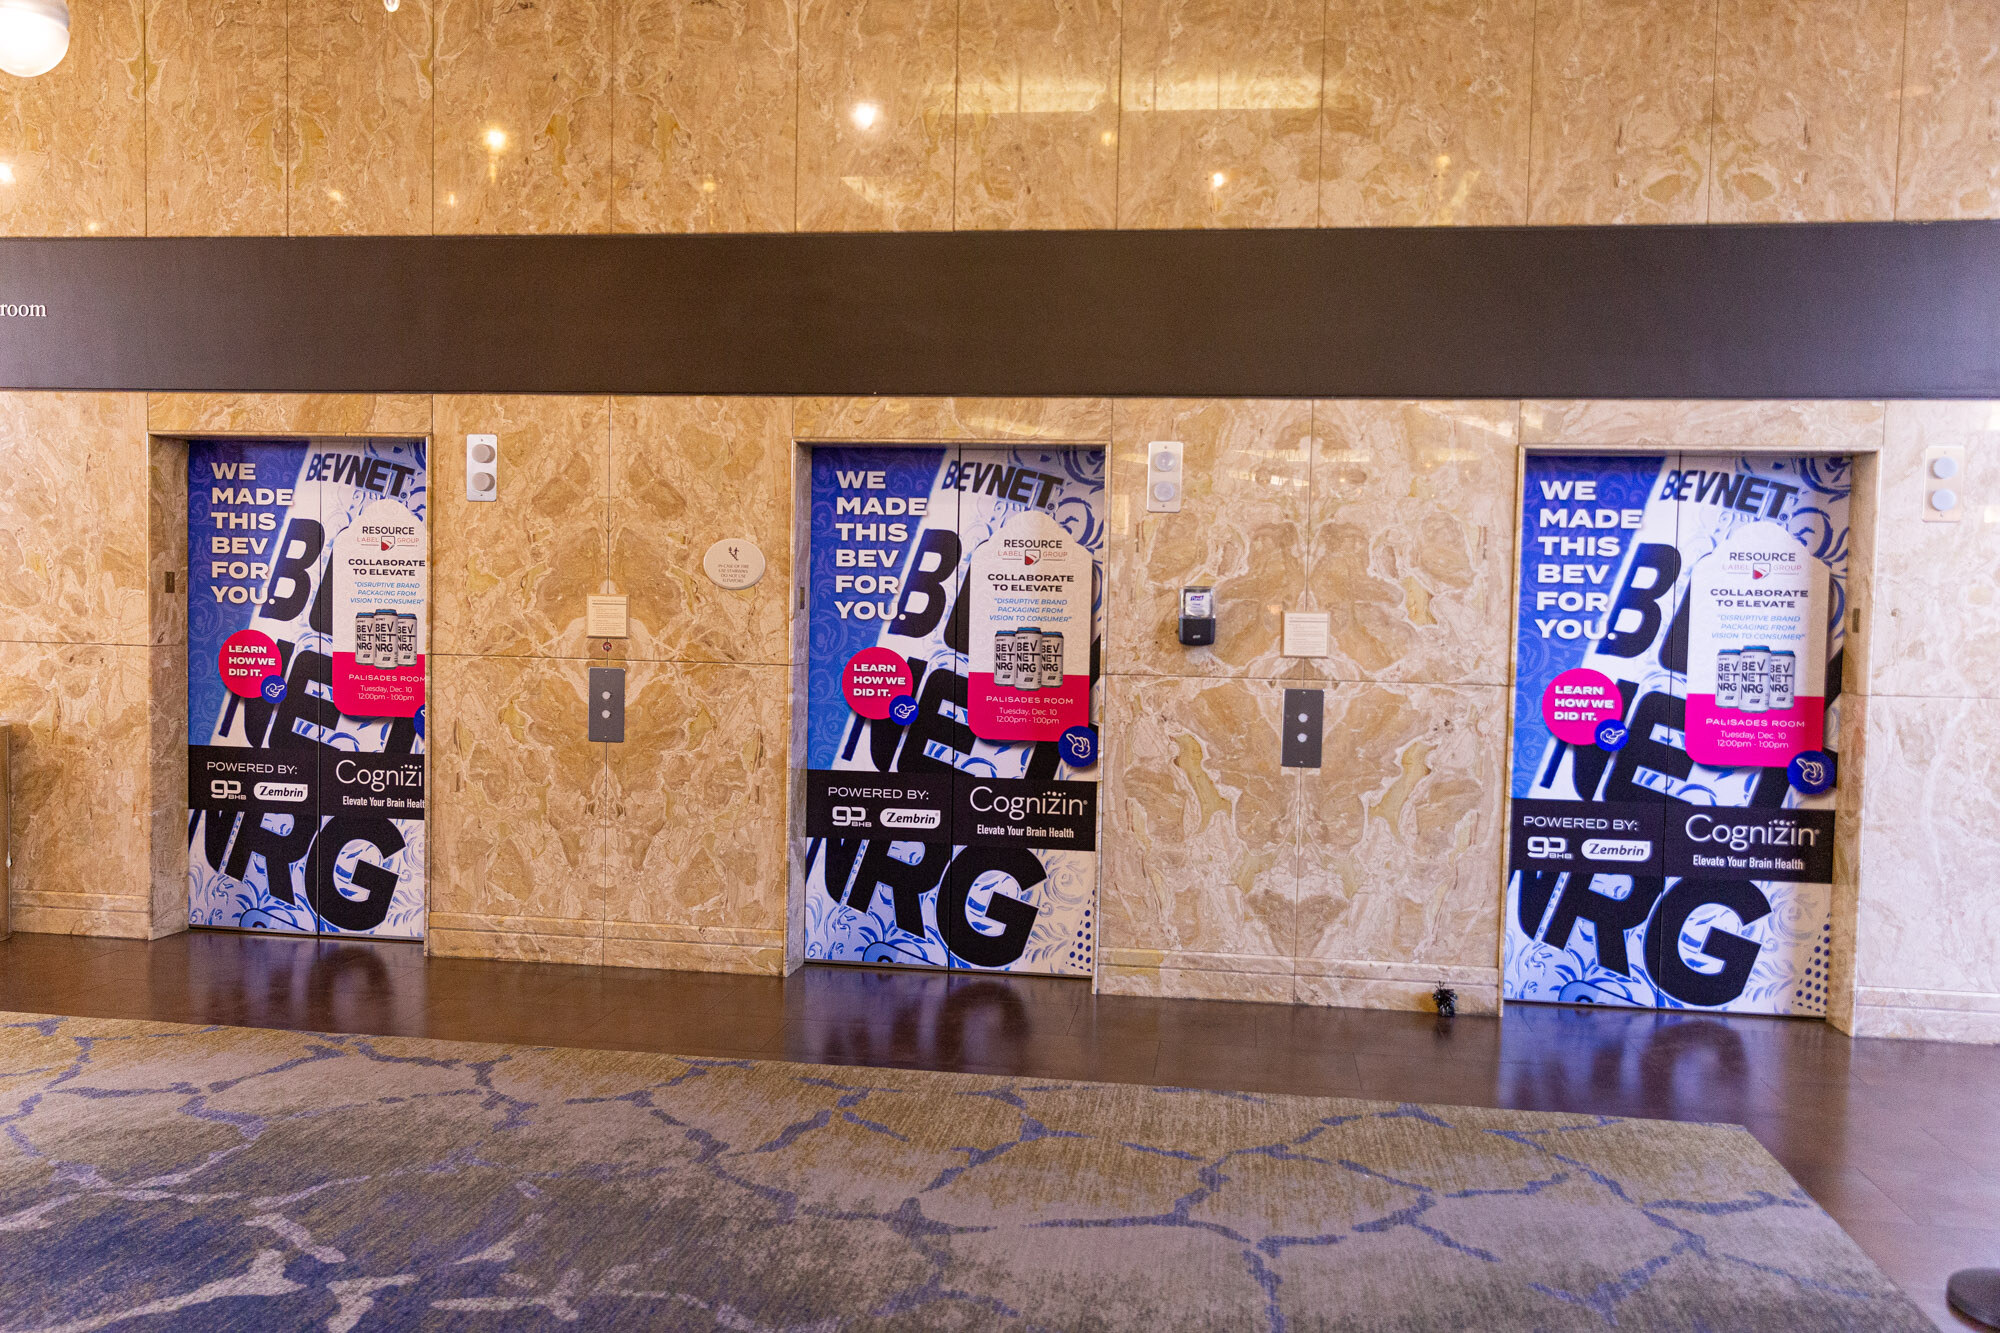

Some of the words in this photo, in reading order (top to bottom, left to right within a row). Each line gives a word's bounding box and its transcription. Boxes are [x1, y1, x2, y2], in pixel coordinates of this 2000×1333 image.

[0, 304, 46, 316] room
[212, 462, 256, 480] WE
[306, 452, 415, 498] BEVNET
[836, 470, 886, 489] WE
[942, 460, 1064, 510] BEVNET
[1540, 480, 1596, 500] WE
[211, 488, 294, 506] MADE
[1659, 470, 1799, 520] BEVNET
[836, 498, 927, 516] MADE
[211, 512, 276, 530] THIS
[1540, 508, 1642, 529] MADE
[362, 526, 415, 535] RESOURCE
[836, 523, 908, 542] THIS
[211, 537, 268, 554] BEV
[1004, 540, 1062, 548] RESOURCE
[1538, 536, 1620, 557] THIS
[836, 550, 899, 568] BEV
[1729, 552, 1796, 562] RESOURCE
[348, 558, 426, 567] COLLABORATE
[211, 562, 269, 580] FOR
[369, 568, 416, 576] ELEVATE
[1538, 564, 1609, 584] BEV
[988, 574, 1074, 582] COLLABORATE
[836, 576, 899, 594] FOR
[1010, 584, 1062, 592] ELEVATE
[211, 586, 275, 604] YOU.
[1710, 588, 1808, 598] COLLABORATE
[1536, 592, 1609, 612] FOR
[1716, 600, 1734, 608] TO
[1736, 600, 1795, 608] ELEVATE
[834, 602, 906, 620] YOU.
[356, 624, 373, 632] BEV
[376, 622, 394, 632] BEV
[1536, 619, 1616, 640] YOU.
[376, 634, 396, 642] NET
[228, 645, 267, 654] LEARN
[356, 642, 372, 650] NRG
[376, 644, 392, 652] NRG
[996, 642, 1014, 652] BEV
[1017, 640, 1038, 652] BEV
[228, 658, 256, 666] HOW
[258, 658, 276, 666] WE
[996, 653, 1015, 661] NET
[1017, 653, 1040, 662] NET
[854, 664, 896, 672] LEARN
[996, 662, 1013, 670] NRG
[1016, 664, 1036, 673] NRG
[1718, 662, 1738, 672] BEV
[1742, 659, 1765, 671] BEV
[250, 669, 262, 677] IT.
[1742, 673, 1768, 682] NET
[854, 676, 884, 684] HOW
[886, 677, 906, 685] WE
[360, 685, 388, 694] Tuesday,
[854, 688, 874, 696] DID
[877, 688, 891, 697] IT.
[1556, 686, 1604, 696] LEARN
[1718, 683, 1737, 692] NRG
[1742, 684, 1763, 694] NRG
[358, 693, 384, 701] 12:00pm
[986, 696, 1040, 704] PALISADES
[1044, 696, 1074, 704] ROOM
[1555, 699, 1589, 708] HOW
[1592, 700, 1614, 709] WE
[999, 708, 1030, 716] Tuesday,
[1554, 712, 1578, 721] DID
[1582, 712, 1597, 722] IT.
[996, 716, 1027, 724] 12:00pm
[1032, 716, 1060, 725] 1:00pm
[1706, 718, 1768, 728] PALISADES
[1772, 720, 1805, 728] ROOM
[1720, 731, 1756, 740] Tuesday,
[1717, 740, 1752, 748] 12:00pm
[1758, 740, 1788, 750] 1:00pm
[207, 762, 274, 773] POWERED
[278, 765, 298, 774] BY:
[260, 786, 304, 798] Zembrin
[828, 787, 902, 799] POWERED
[907, 790, 929, 800] BY:
[343, 796, 368, 806] Elevate
[370, 797, 385, 806] Your
[386, 797, 405, 808] Brain
[886, 812, 935, 824] Zembrin
[1524, 816, 1607, 830] POWERED
[1614, 819, 1639, 830] BY:
[977, 824, 1005, 836] Elevate
[1006, 825, 1024, 836] Your
[1026, 826, 1046, 837] Brain
[1050, 827, 1074, 838] Health
[1590, 843, 1644, 856] Zembrin
[1693, 855, 1724, 866] Elevate
[1727, 856, 1746, 868] Your
[1749, 858, 1772, 869] Brain
[1774, 858, 1804, 870] Health
